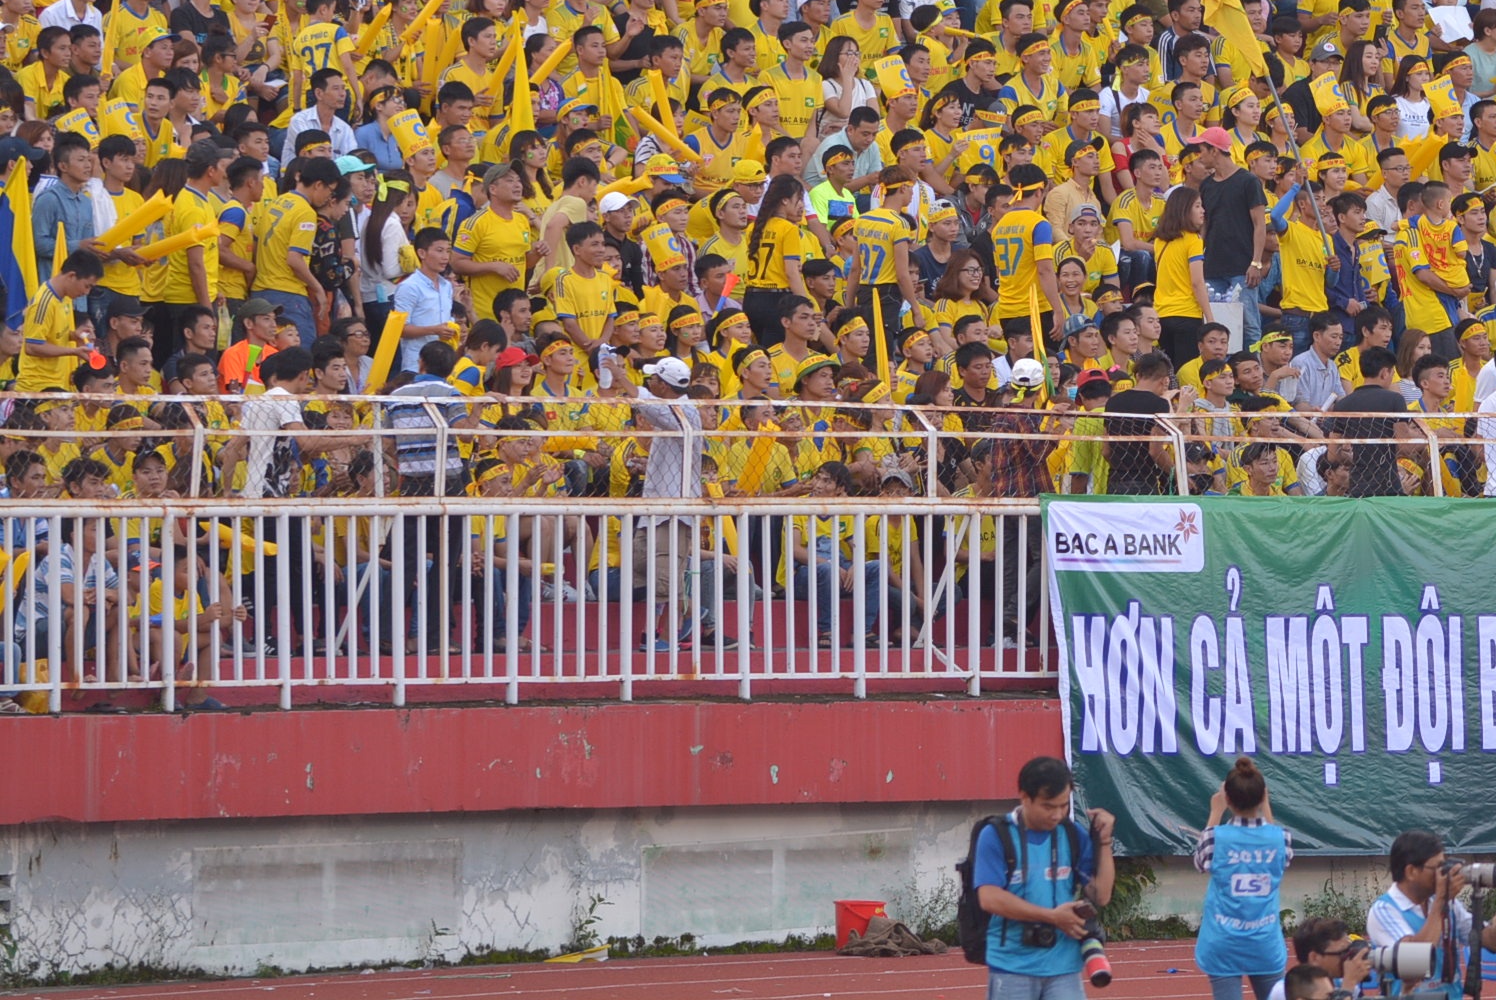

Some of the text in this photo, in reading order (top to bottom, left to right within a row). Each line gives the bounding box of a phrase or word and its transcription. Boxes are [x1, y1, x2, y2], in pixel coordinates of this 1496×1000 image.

[979, 144, 995, 166] 9
[996, 237, 1023, 276] 37
[1055, 532, 1182, 556] BAC A BANK
[1071, 601, 1179, 756] HƠN
[1190, 565, 1257, 756] CẢ
[1265, 583, 1370, 786] MỘT
[1381, 583, 1466, 785] ĐỘI
[1227, 848, 1277, 865] 2017
[1235, 879, 1262, 893] LS
